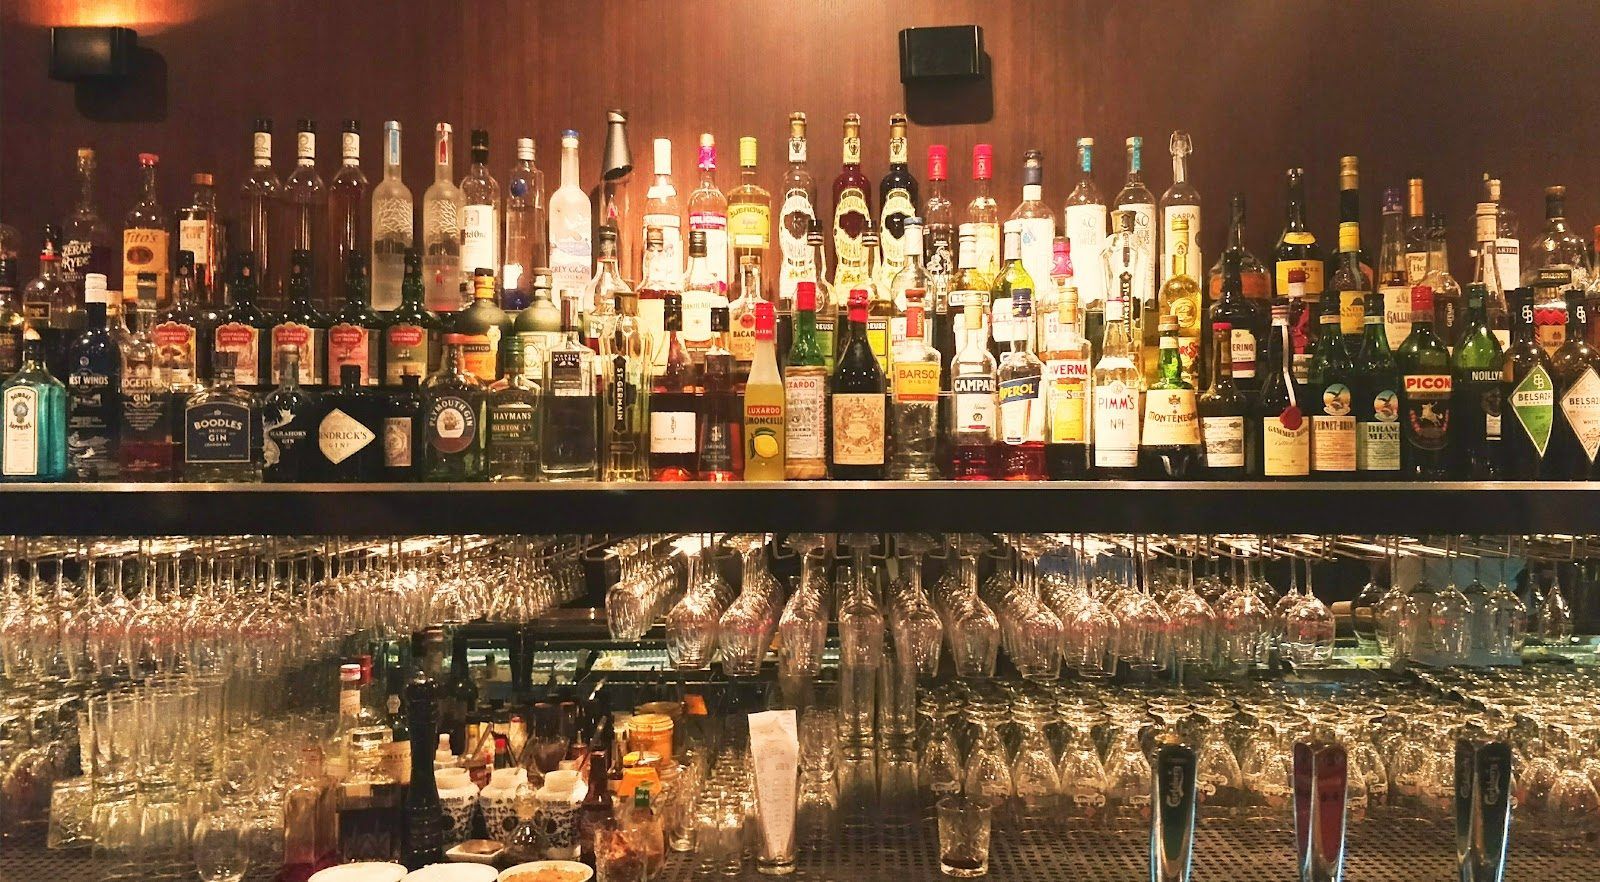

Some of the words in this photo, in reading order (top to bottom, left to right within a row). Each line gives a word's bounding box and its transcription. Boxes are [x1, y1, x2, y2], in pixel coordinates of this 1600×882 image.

[126, 231, 159, 244] Tito's
[61, 242, 92, 257] ZERAC
[1232, 343, 1255, 352] ERING
[899, 369, 938, 379] BARSOL
[1471, 371, 1498, 381] NOILLY
[83, 376, 109, 385] WINDS
[1406, 377, 1451, 389] PICON
[133, 394, 151, 402] GIN
[616, 367, 624, 421] ST-GERMAIN
[1098, 394, 1135, 410] PIMM'S
[429, 399, 467, 426] PLYMOUTH
[463, 407, 474, 427] GIN
[748, 406, 780, 414] LUXARDO
[1149, 411, 1197, 423] MONTENEG
[194, 419, 243, 430] BOODLES
[208, 434, 227, 442] GIN
[1166, 766, 1184, 807] Carlsberg
